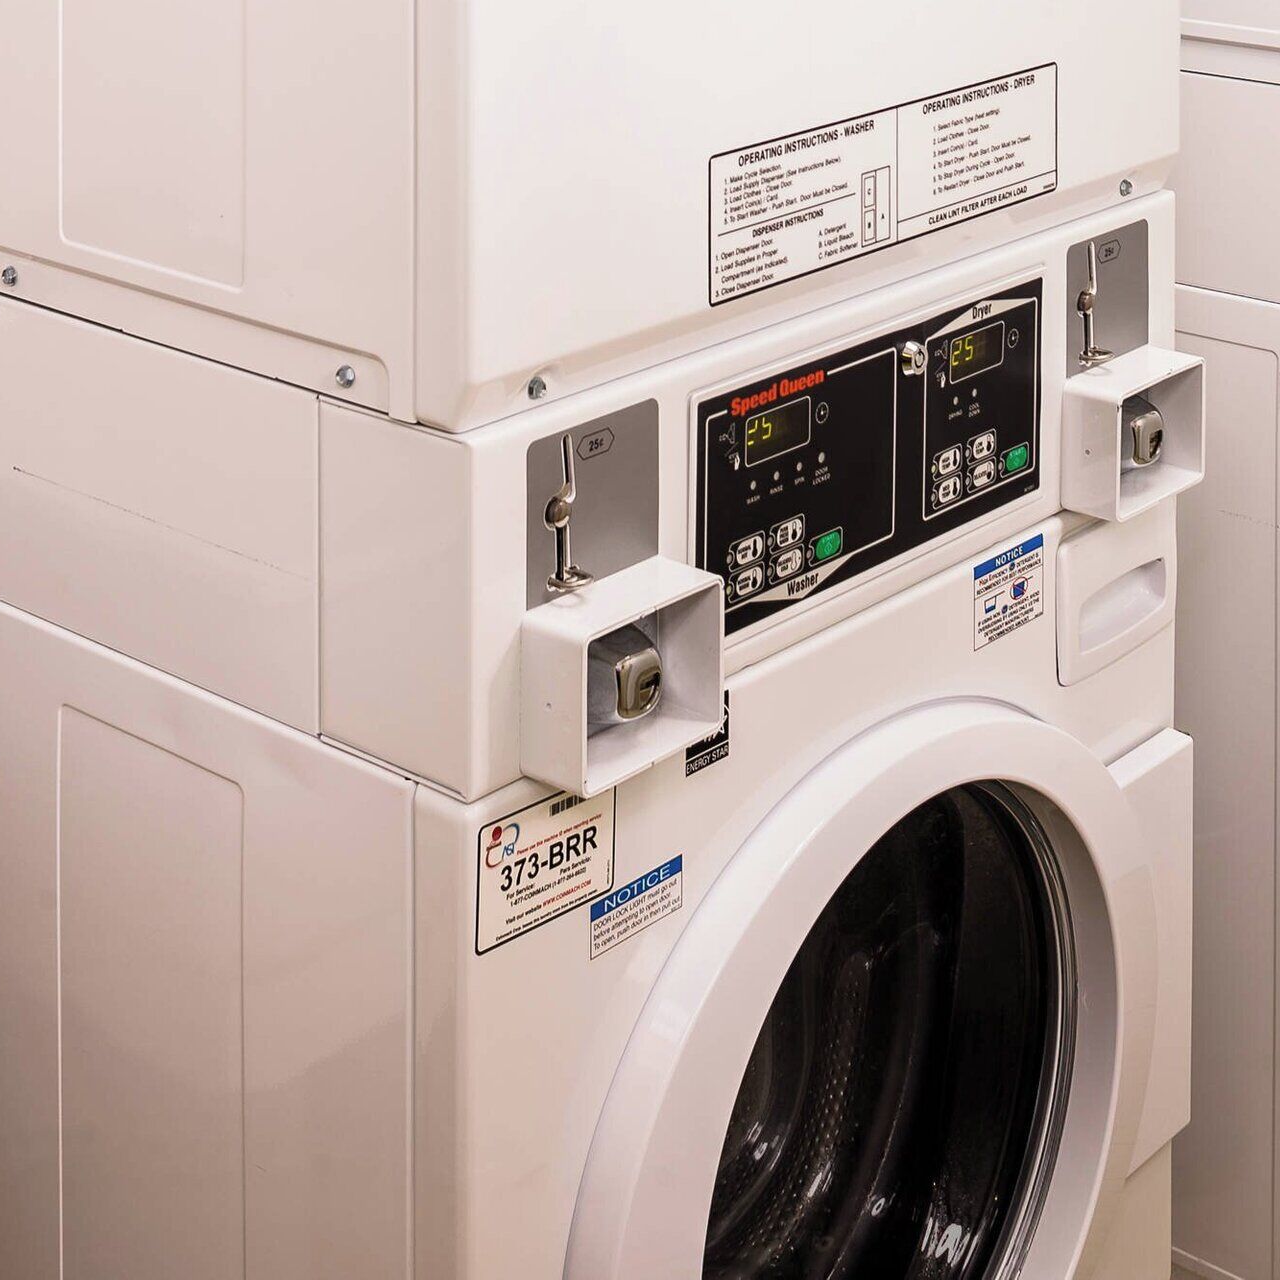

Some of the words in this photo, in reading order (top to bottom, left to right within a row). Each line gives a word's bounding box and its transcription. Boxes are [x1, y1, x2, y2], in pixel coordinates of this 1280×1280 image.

[922, 95, 960, 114] OPERATING
[962, 81, 1008, 103] INSTRUCTIONS
[1014, 74, 1035, 89] DRYER
[738, 145, 782, 167] OPERATING
[784, 129, 838, 154] INSTRUCTIONS
[844, 120, 874, 137] WASHER
[752, 220, 783, 238] DISPENSER
[785, 208, 824, 228] INSTRUCTIONS
[929, 213, 947, 225] CLEAN
[948, 208, 960, 217] LINT
[961, 201, 979, 214] FILTER
[980, 193, 997, 207] AFTER
[998, 190, 1012, 202] EACH
[1013, 186, 1027, 196] LOAD
[972, 304, 992, 319] Dryer
[952, 336, 973, 366] 25
[731, 383, 777, 416] Speed
[780, 369, 825, 397] Queen
[995, 546, 1024, 566] NOTICE
[787, 572, 819, 596] Washer
[686, 754, 711, 774] ENERGY
[712, 745, 729, 760] STAR
[500, 826, 597, 892] 373-BRR
[560, 866, 571, 875] Para
[505, 916, 515, 924] Visit
[525, 903, 542, 916] website
[543, 879, 592, 908] WWW.COINMACH.COM
[506, 892, 515, 900] For
[593, 915, 611, 931] DOOR
[613, 906, 629, 922] LOCK
[630, 896, 646, 911] LIGHT
[648, 889, 660, 901] must
[661, 885, 668, 894] go
[669, 879, 677, 888] out
[604, 864, 670, 912] NOTICE
[593, 927, 610, 941] before
[612, 911, 638, 932] attempting
[639, 906, 644, 914] to
[645, 899, 658, 911] open
[593, 942, 600, 950] To
[617, 925, 630, 939] push
[631, 917, 642, 929] door
[649, 907, 661, 918] then
[662, 901, 671, 913] pull
[672, 896, 680, 905] out
